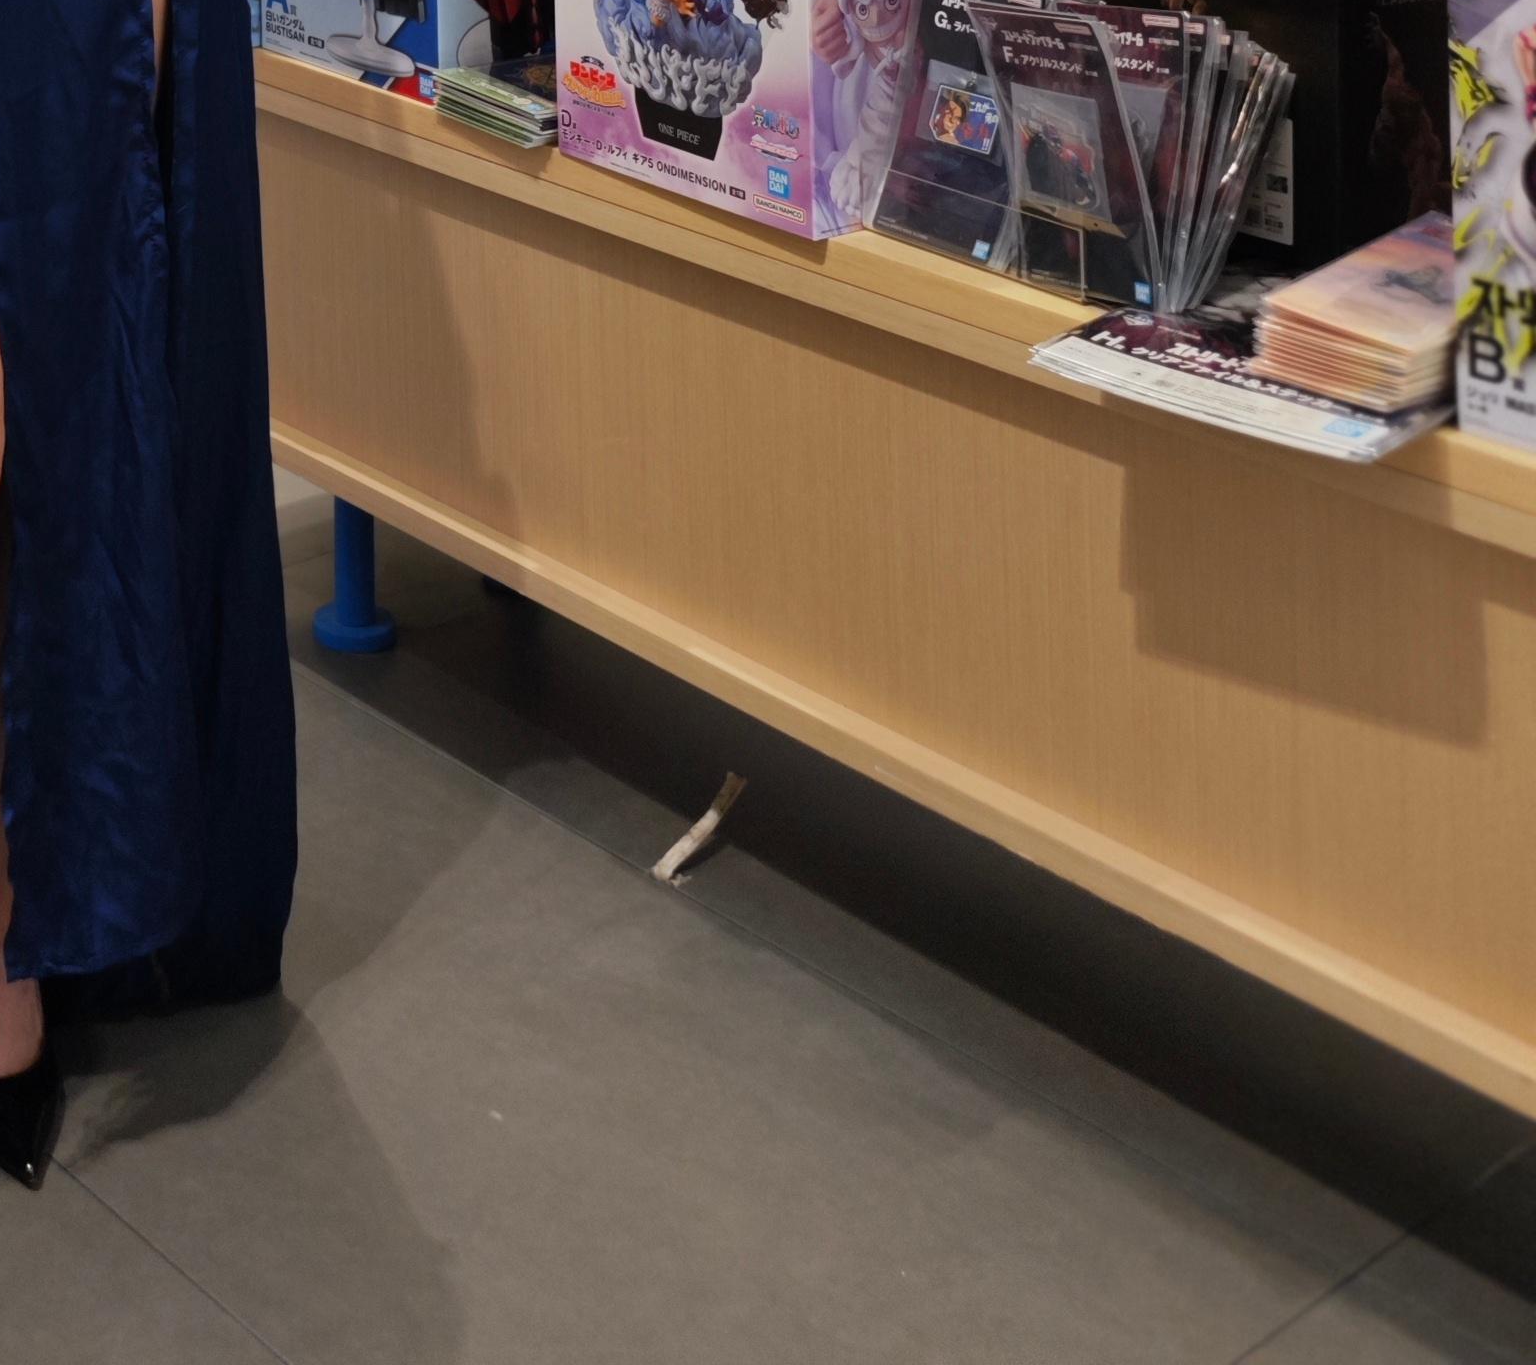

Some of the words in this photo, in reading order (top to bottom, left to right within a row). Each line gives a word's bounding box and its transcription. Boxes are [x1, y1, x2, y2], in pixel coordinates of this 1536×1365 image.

[265, 21, 305, 44] BUSTISAN
[658, 122, 676, 138] ONE
[677, 128, 701, 146] PIECE
[656, 160, 727, 195] ONDIMENSION
